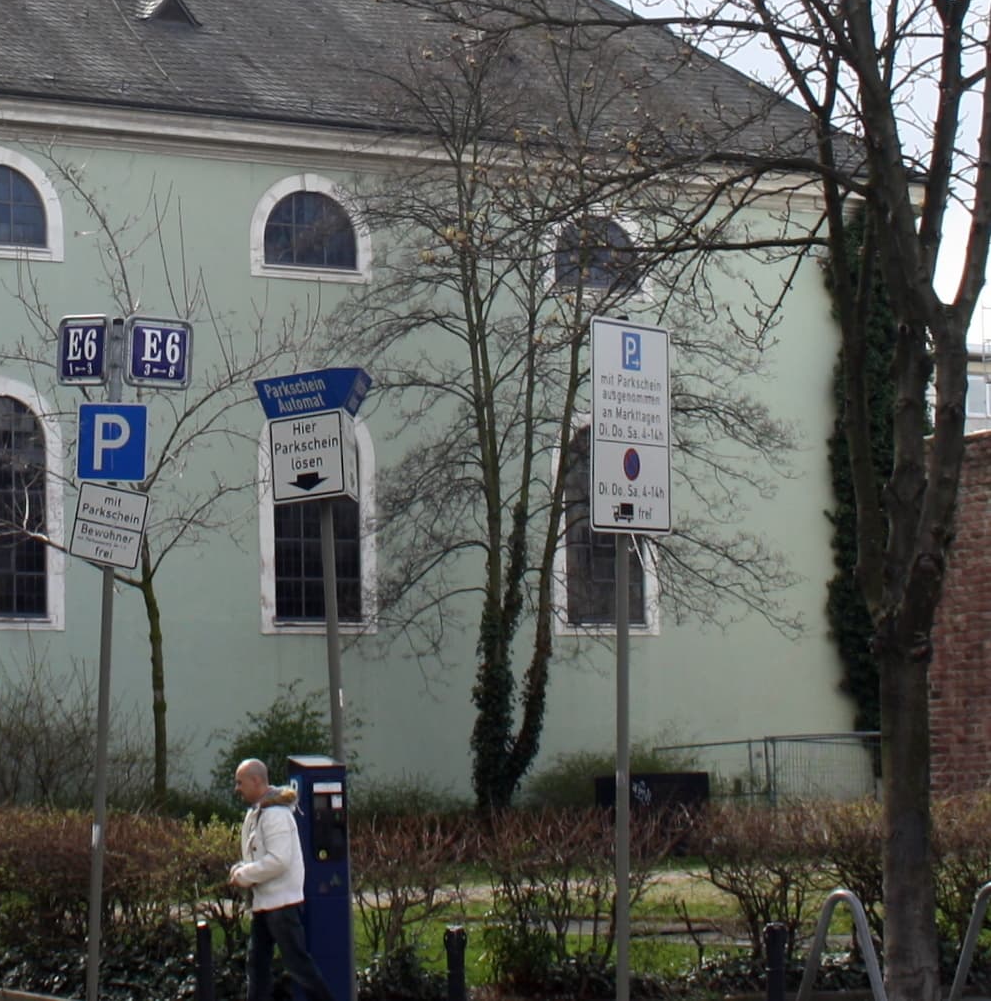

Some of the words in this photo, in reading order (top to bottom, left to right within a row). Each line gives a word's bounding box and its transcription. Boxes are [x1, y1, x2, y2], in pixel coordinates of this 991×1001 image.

[67, 327, 97, 361] E6
[141, 328, 181, 364] E6
[625, 336, 637, 365] P
[263, 377, 326, 399] Parkschein
[600, 374, 614, 385] mit
[617, 374, 662, 392] Parkschein
[277, 392, 326, 414] Automat
[602, 389, 661, 406] ausgenommen
[615, 406, 662, 426] Markttagen
[293, 422, 317, 436] Hier
[93, 413, 131, 471] P
[274, 435, 339, 456] Parkschein
[104, 496, 122, 507] mit
[82, 502, 140, 525] Parkschein
[638, 506, 653, 520] frei
[80, 522, 134, 544] Bewohner
[95, 546, 113, 559] frei
